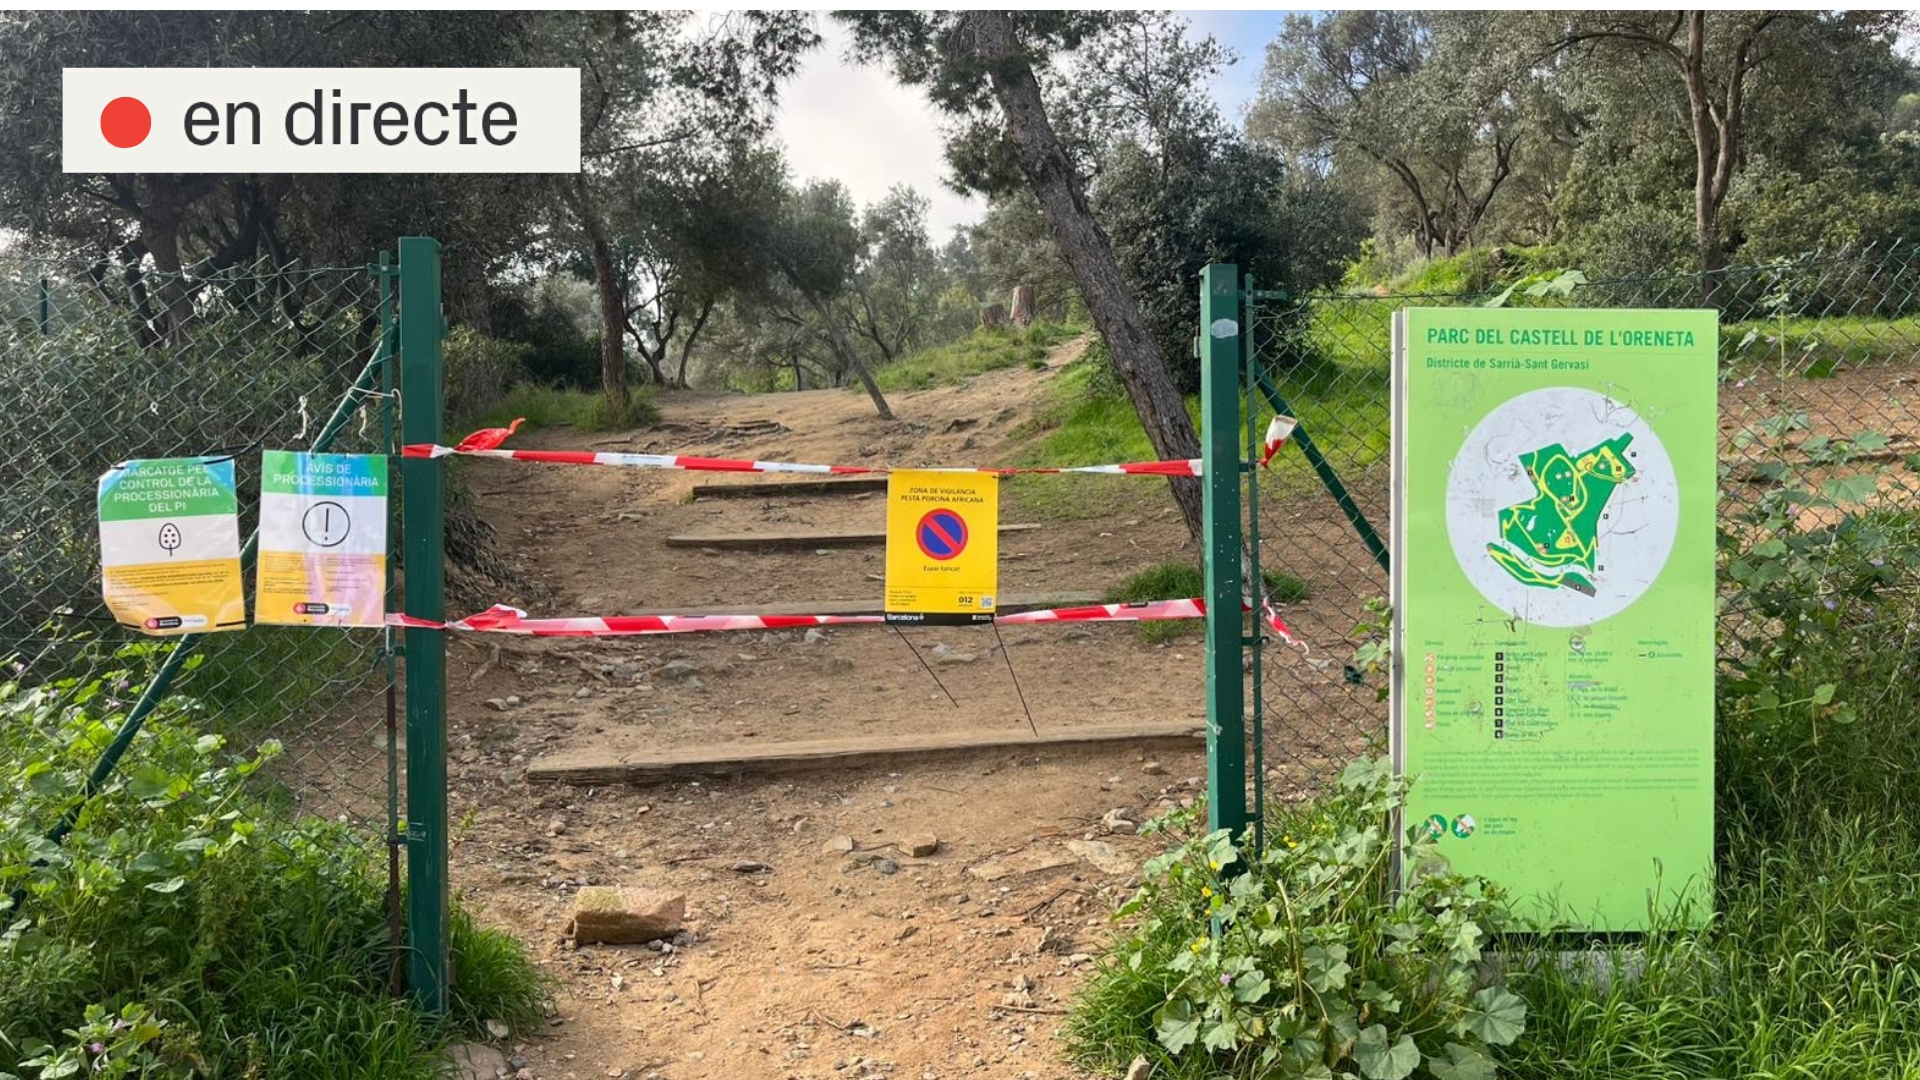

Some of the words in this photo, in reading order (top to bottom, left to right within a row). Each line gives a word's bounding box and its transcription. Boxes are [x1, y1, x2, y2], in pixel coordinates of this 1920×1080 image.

[1427, 328, 1469, 344] PARC
[1475, 329, 1504, 345] DEL
[1510, 329, 1578, 346] CASTELL
[1584, 330, 1604, 346] DE
[1610, 330, 1694, 347] L'ORENETA
[1426, 357, 1470, 369] Districte
[1473, 357, 1486, 369] de
[1489, 357, 1548, 370] Sarrià-Sant
[1551, 358, 1589, 370] Gervasi
[187, 463, 210, 474] PEL
[336, 463, 352, 474] DE
[120, 478, 176, 490] CONTROL
[178, 477, 195, 486] DE
[197, 476, 212, 485] LA
[114, 487, 220, 502] PROCESSIONÀRIA
[149, 502, 172, 513] DEL
[175, 501, 187, 511] PI
[958, 596, 973, 604] 012
[886, 613, 919, 621] Barcelona
